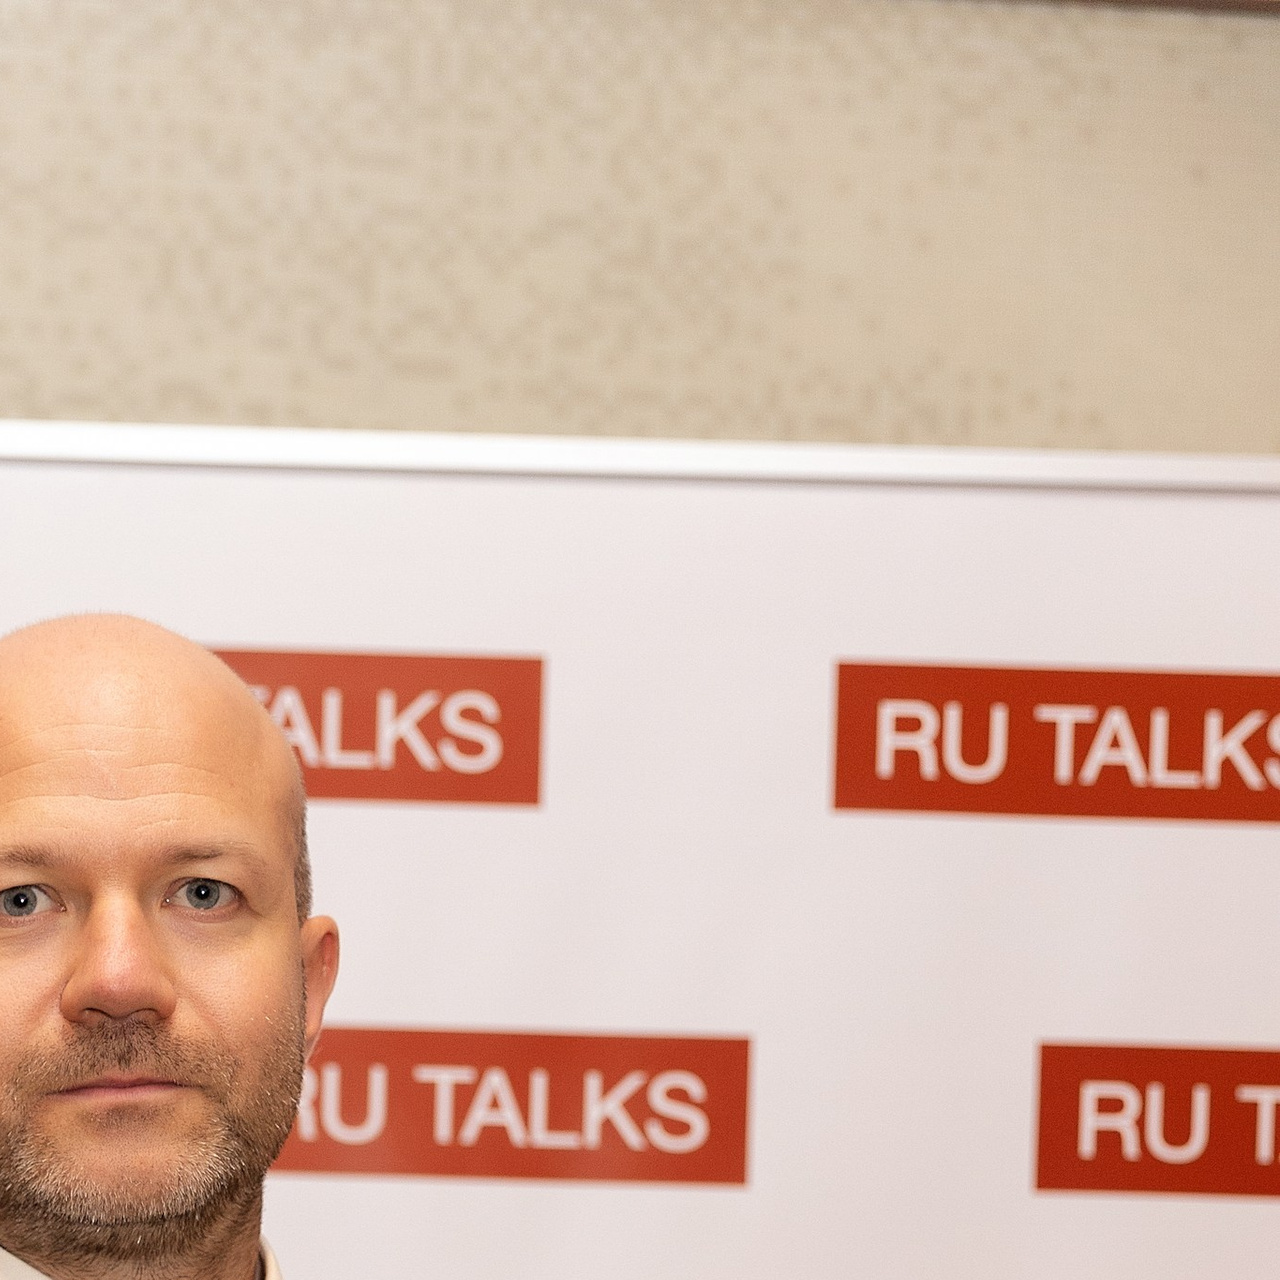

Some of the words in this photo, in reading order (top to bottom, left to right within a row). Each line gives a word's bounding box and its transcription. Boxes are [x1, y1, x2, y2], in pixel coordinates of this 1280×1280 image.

[248, 683, 506, 777] ALKS
[873, 697, 1011, 786] RU
[1031, 702, 1280, 792] TALK
[410, 1062, 712, 1157] TALKS
[1075, 1079, 1213, 1166] RU
